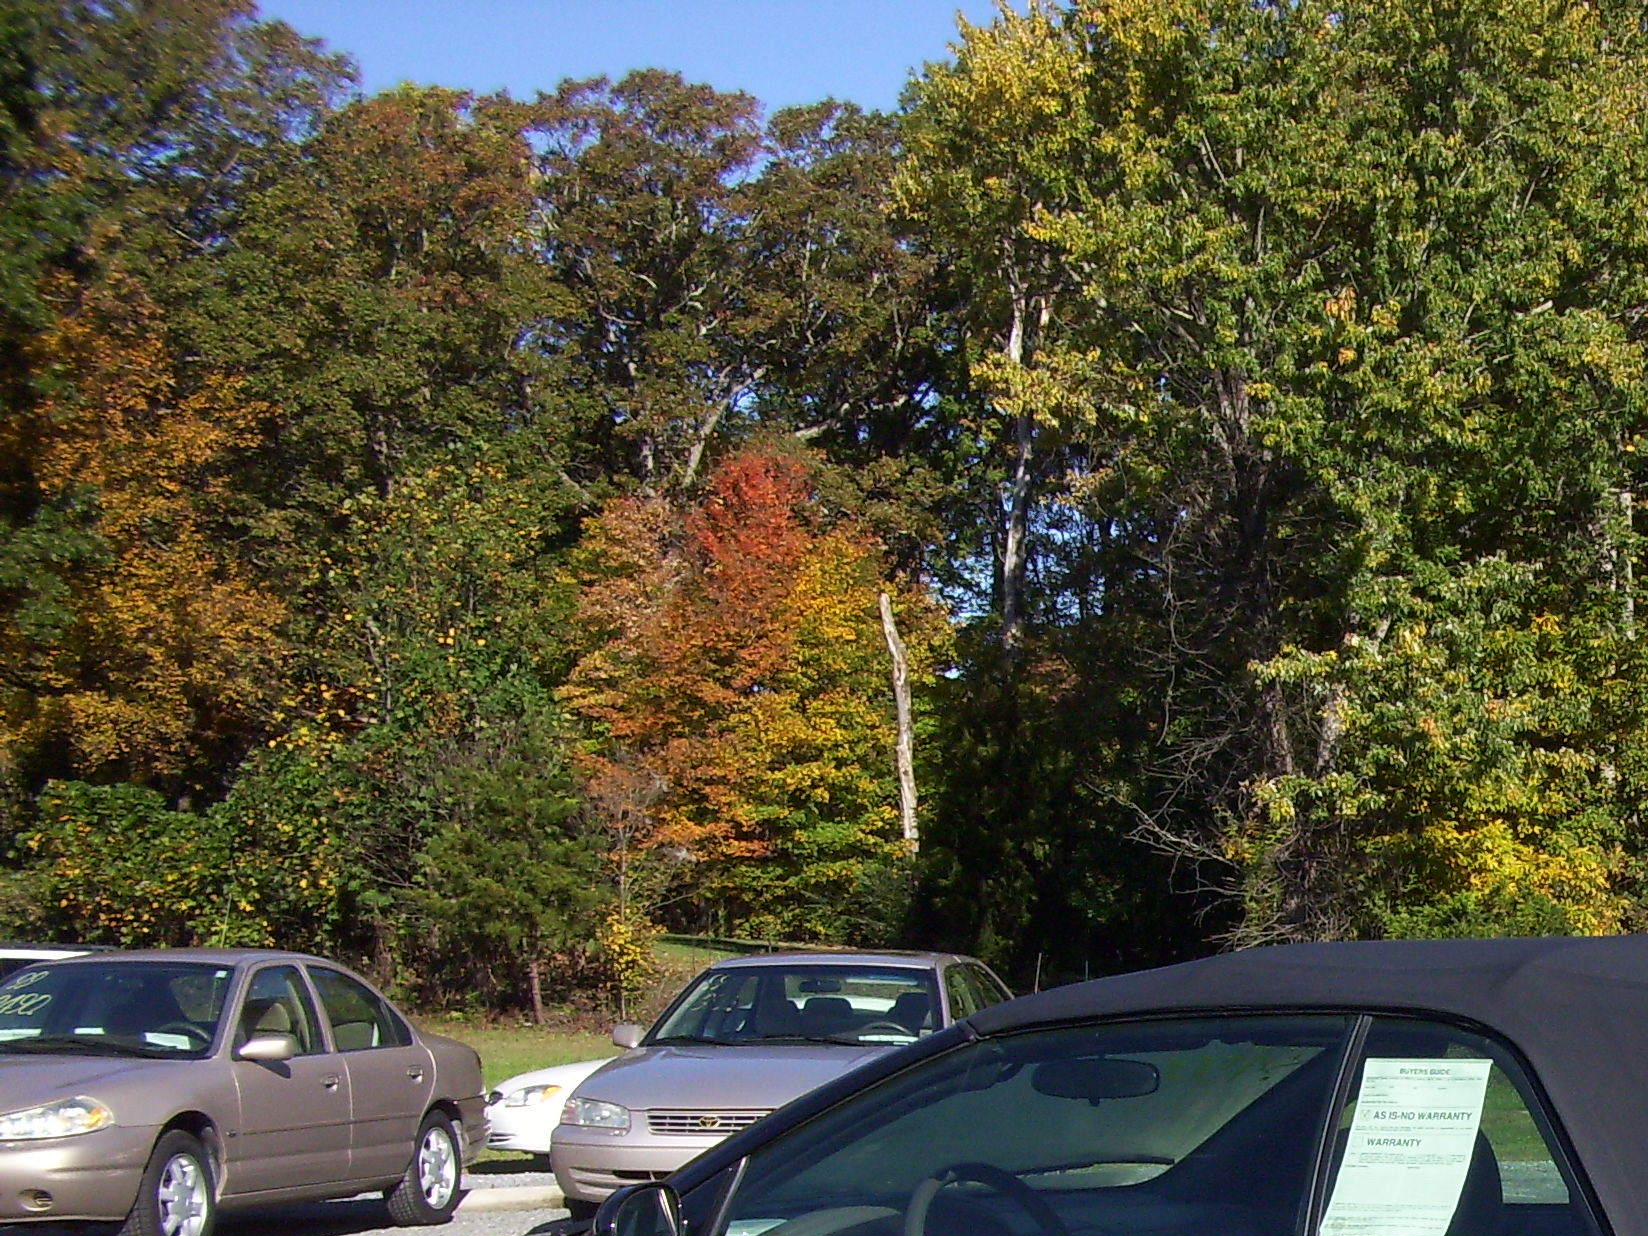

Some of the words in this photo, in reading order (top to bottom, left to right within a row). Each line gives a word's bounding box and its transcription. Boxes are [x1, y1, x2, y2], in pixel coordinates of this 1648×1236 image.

[1373, 1111, 1386, 1120] AS
[1417, 1112, 1472, 1121] WARRANTY
[1367, 1138, 1422, 1147] WARRANTY
